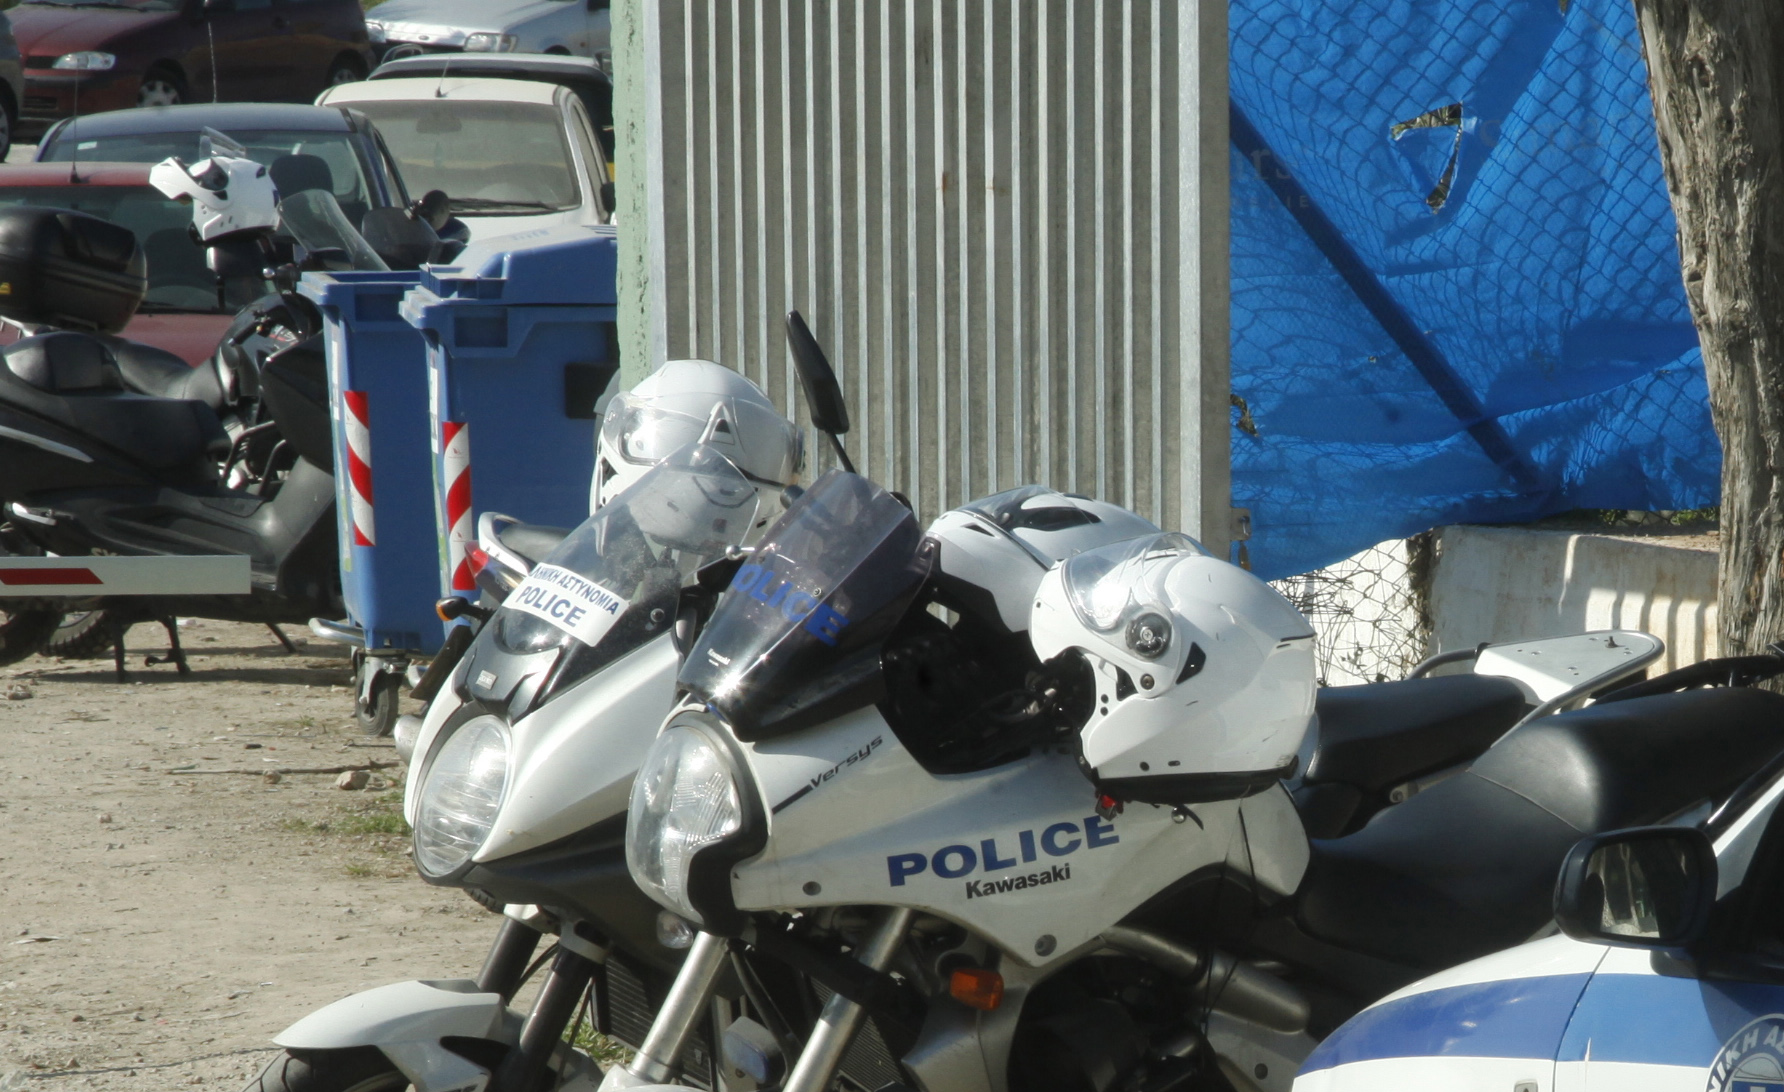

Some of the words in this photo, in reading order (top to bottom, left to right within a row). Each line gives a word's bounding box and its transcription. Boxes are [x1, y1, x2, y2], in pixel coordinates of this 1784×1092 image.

[514, 585, 588, 628] POLICE
[555, 573, 620, 616] ΑΣΤΥΝΟΜΙΑ
[730, 563, 850, 648] OLICE
[809, 734, 884, 789] Versys
[886, 814, 1120, 888] POLICE
[965, 862, 1071, 900] Kawasaki
